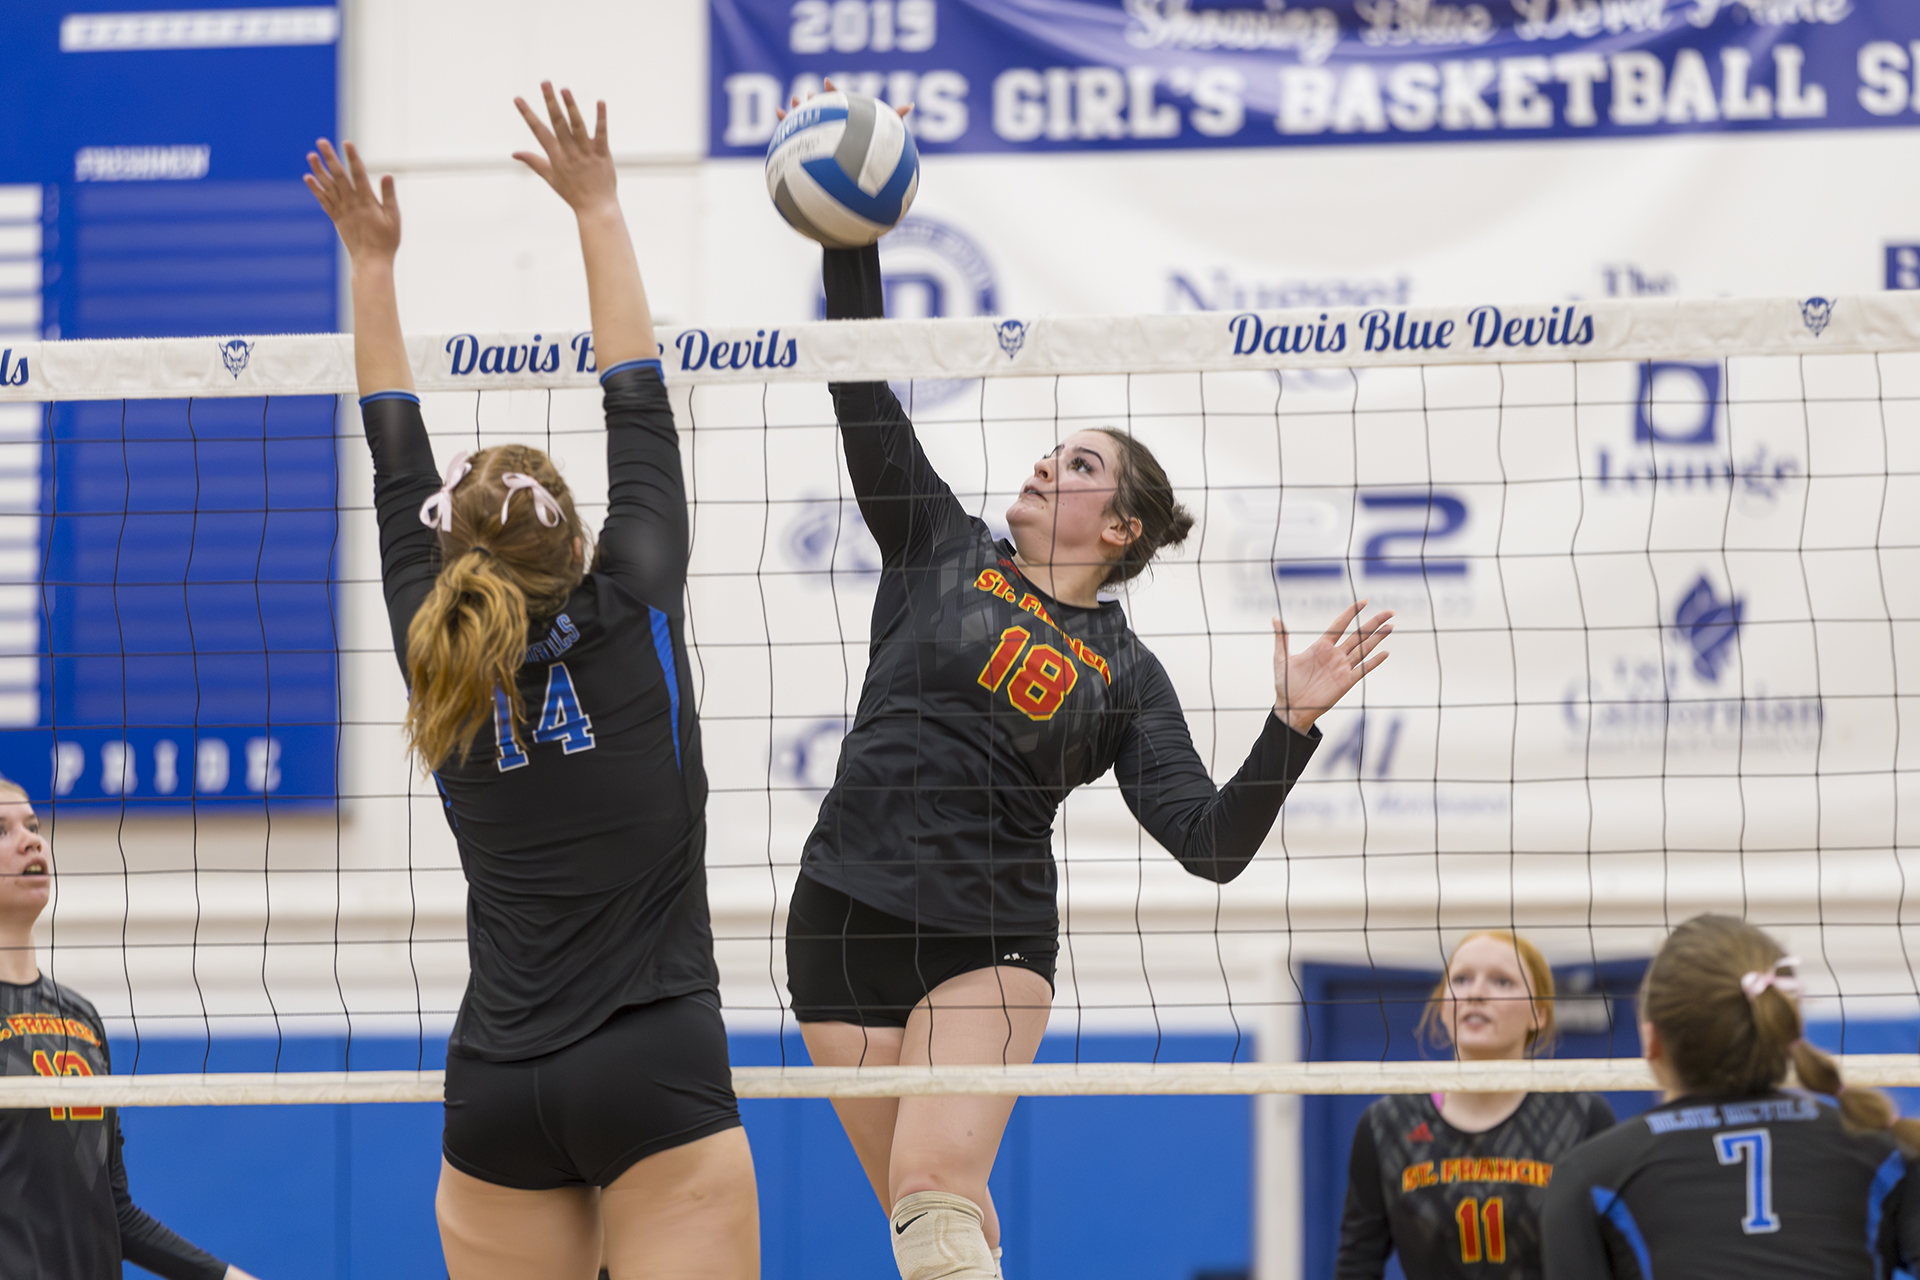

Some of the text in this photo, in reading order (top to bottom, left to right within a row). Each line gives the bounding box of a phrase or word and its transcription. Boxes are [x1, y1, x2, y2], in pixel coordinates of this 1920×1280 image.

[993, 67, 1246, 141] GIRL'S
[1275, 44, 1828, 135] BASKETBALL
[446, 333, 560, 375] Davis
[675, 329, 798, 371] Devils
[1228, 304, 1596, 355] Davis Blue Devils
[974, 568, 1017, 603] ST.
[525, 612, 581, 664] ILS
[977, 625, 1078, 721] 18
[491, 661, 596, 772] 14
[1713, 1127, 1781, 1235] 7
[1455, 1196, 1506, 1264] 11
